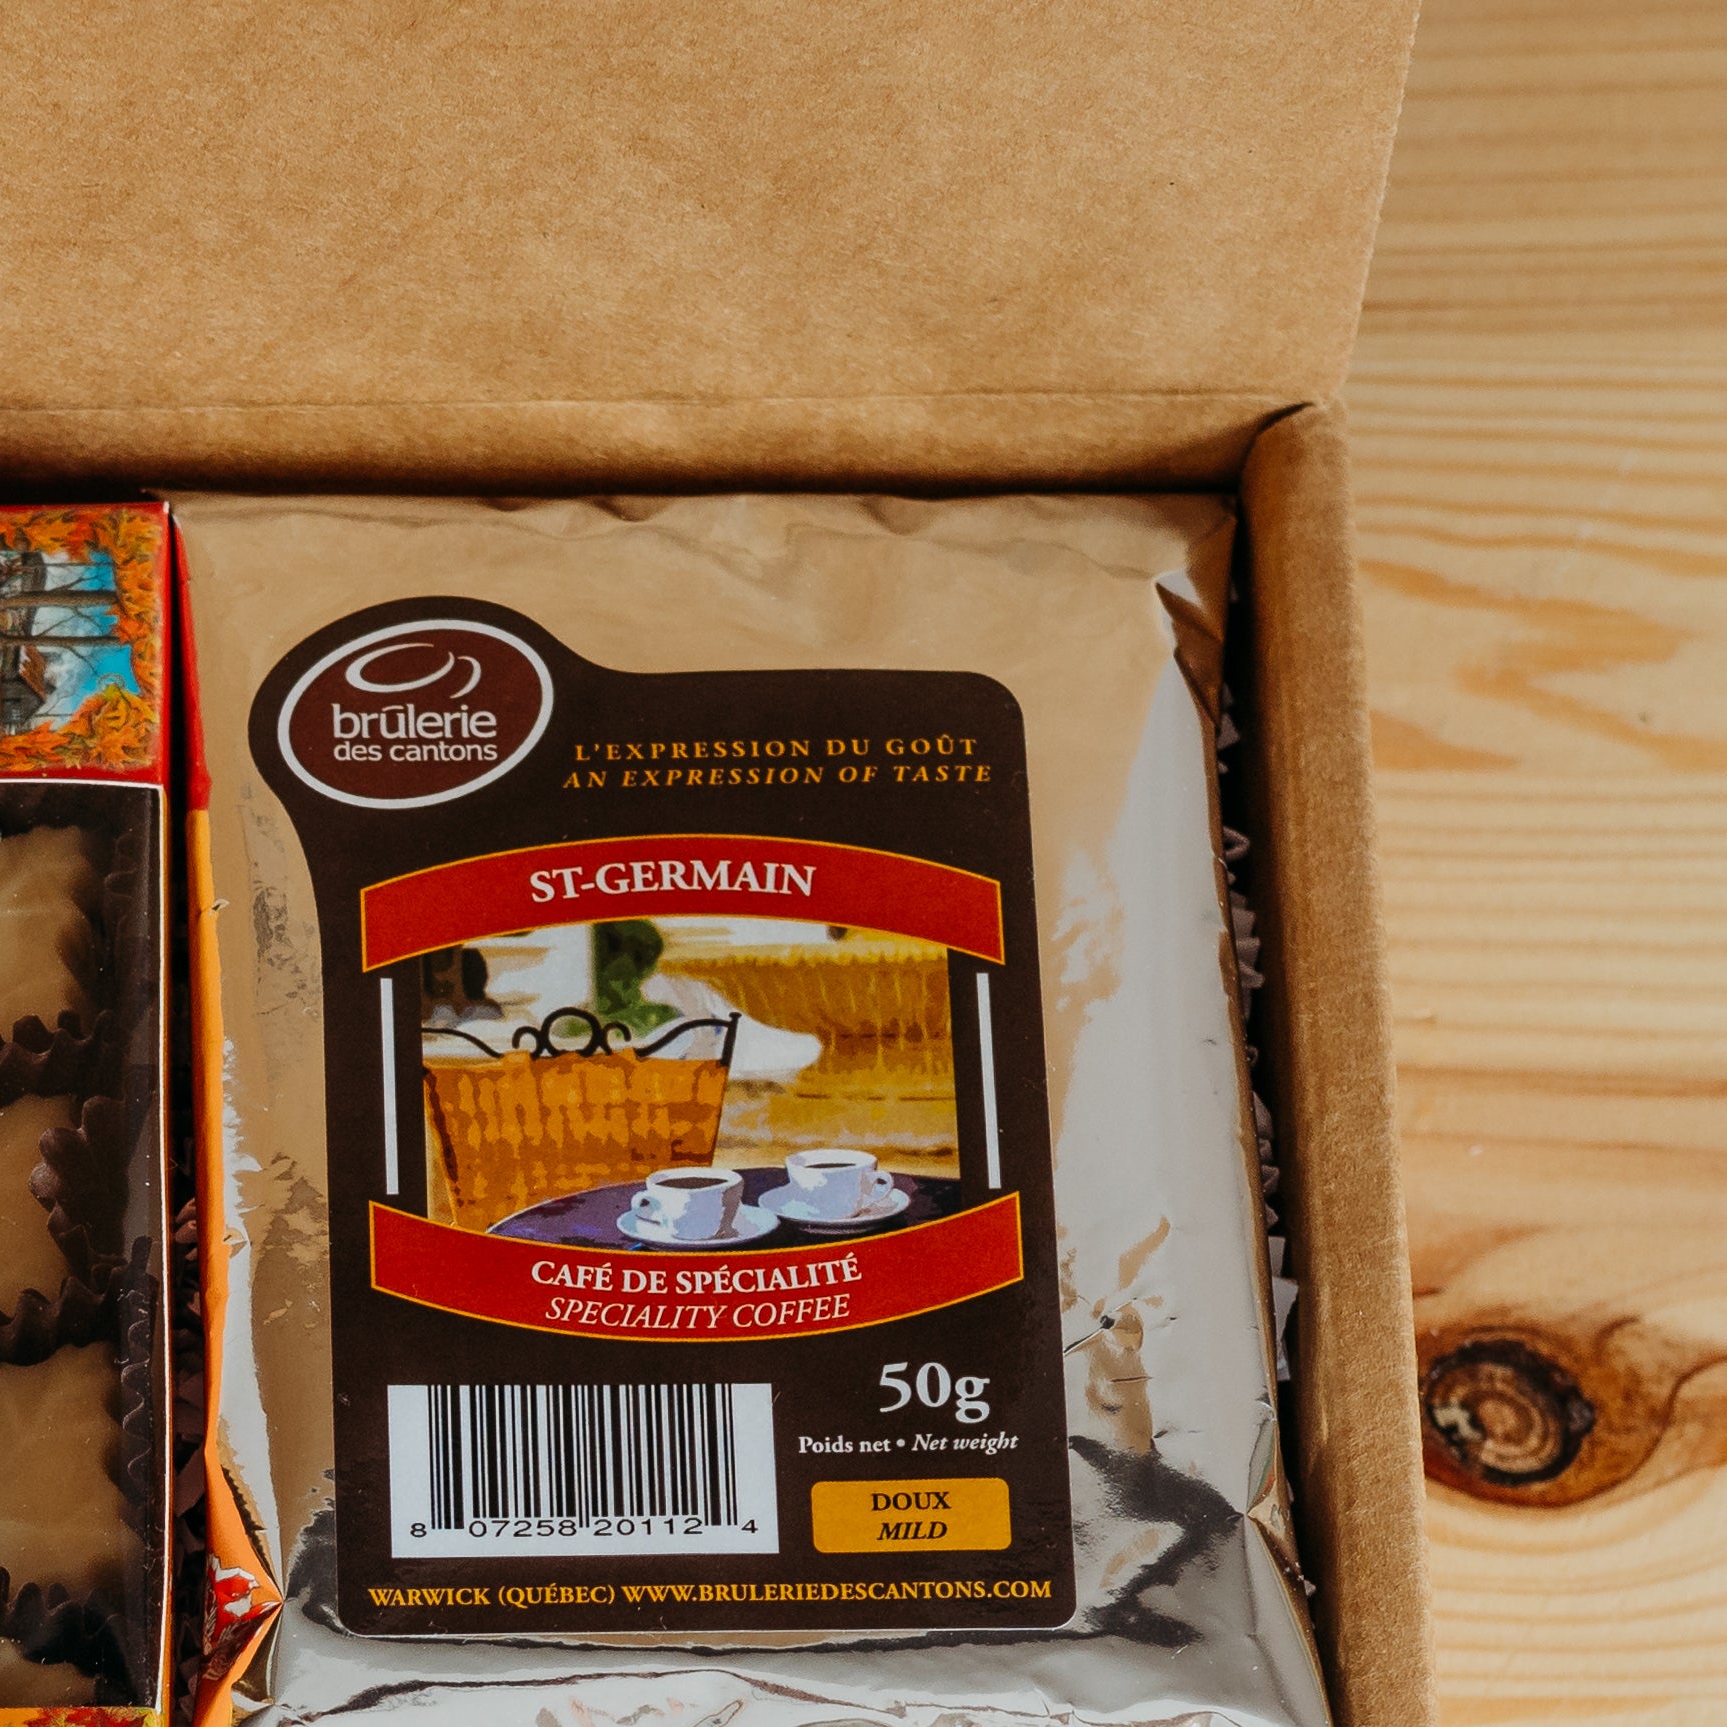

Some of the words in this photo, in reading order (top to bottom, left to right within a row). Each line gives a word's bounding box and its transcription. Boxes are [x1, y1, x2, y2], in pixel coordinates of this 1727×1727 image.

[334, 741, 382, 761] des
[389, 741, 498, 761] cantons
[575, 740, 810, 761] L'EXPRESSION
[827, 739, 870, 757] DU
[885, 734, 977, 756] GOÛT
[563, 771, 607, 788] AN
[621, 767, 824, 787] EXPRESSION
[839, 766, 878, 783] OF
[893, 764, 992, 783] TASTE
[531, 861, 816, 904] ST-GERMAIN
[531, 1261, 613, 1291] CAFÉ
[622, 1269, 668, 1294] DE
[675, 1252, 861, 1294] SPÉCIALITÉ
[546, 1297, 727, 1329] SPECIALITY
[733, 1293, 850, 1328] COFFEE
[879, 1361, 990, 1424] 50g
[798, 1435, 853, 1453] Poids
[860, 1439, 892, 1452] net
[912, 1434, 947, 1451] Net
[953, 1431, 1019, 1455] weight
[871, 1492, 950, 1511] DOUX
[410, 1523, 426, 1538] 8
[469, 1520, 577, 1537] 07258
[593, 1519, 702, 1536] 20112
[741, 1520, 758, 1534] 4
[877, 1522, 947, 1540] MILD
[368, 1587, 490, 1607] WARWICK
[498, 1584, 615, 1609] (QUÉBEC)
[622, 1580, 1052, 1604] WWW.BRULERIEDESCANTONS.COM
